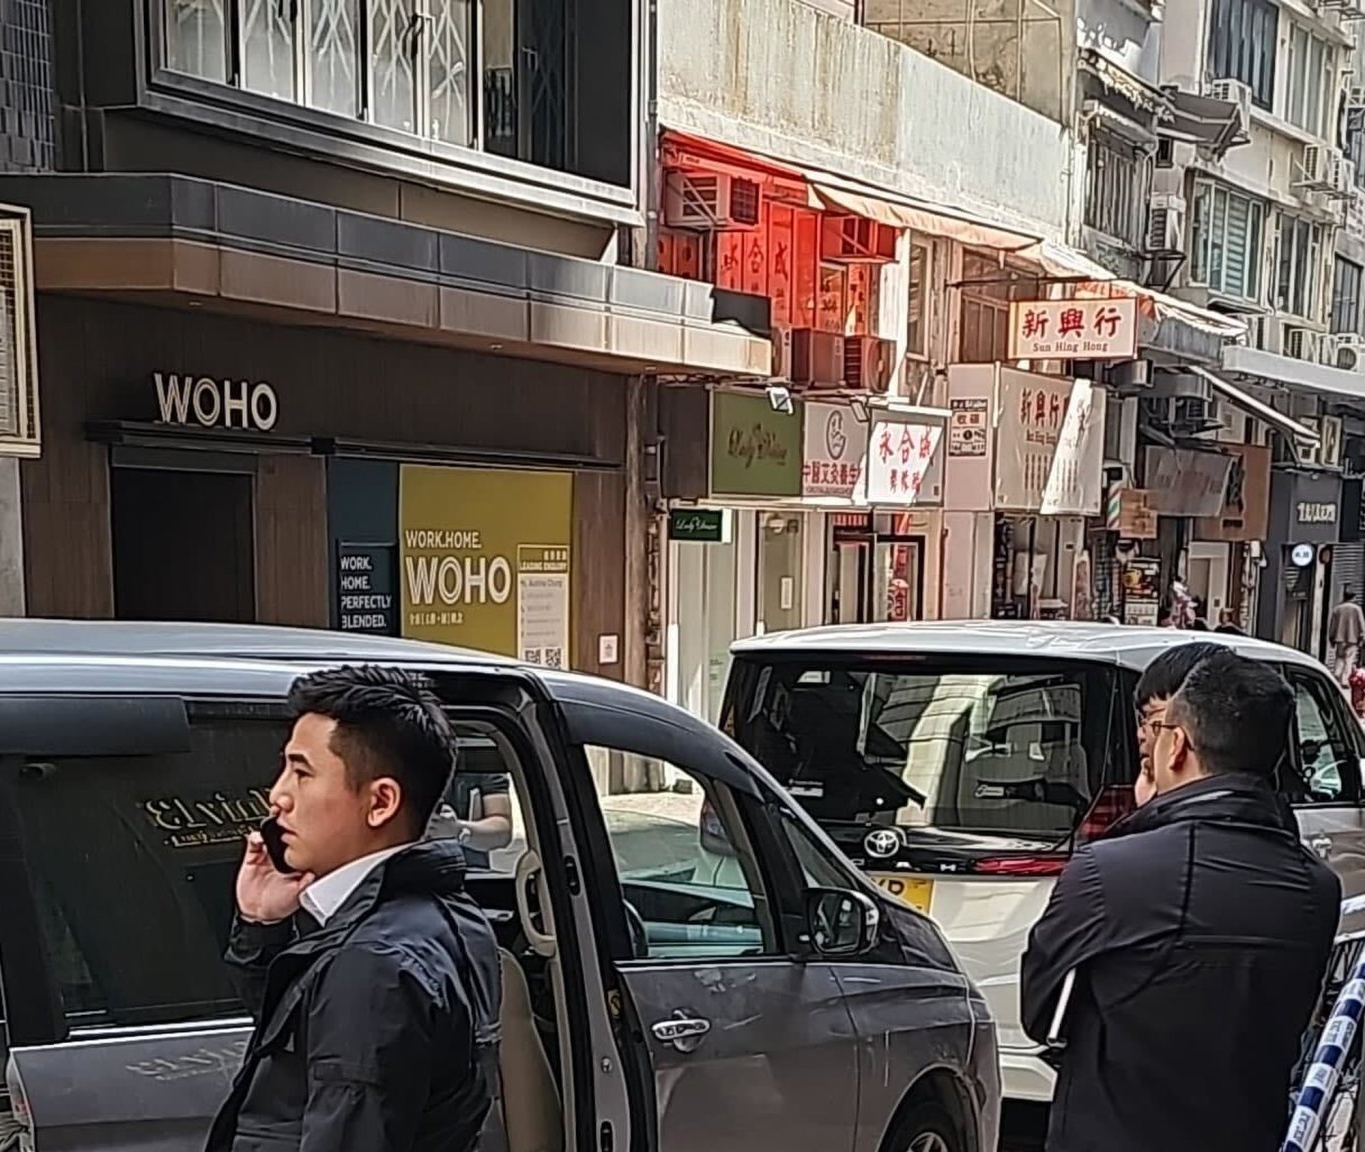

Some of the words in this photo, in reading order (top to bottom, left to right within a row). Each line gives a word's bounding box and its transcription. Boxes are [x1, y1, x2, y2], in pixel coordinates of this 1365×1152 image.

[1022, 307, 1122, 338] 新興行
[1033, 342, 1051, 352] Sun
[1055, 342, 1079, 353] Hing
[1083, 341, 1109, 352] Hong
[154, 373, 276, 430] WOHO
[1020, 387, 1070, 429] 新興行
[405, 556, 511, 604] WOHO
[340, 595, 392, 609] PERFECTLY
